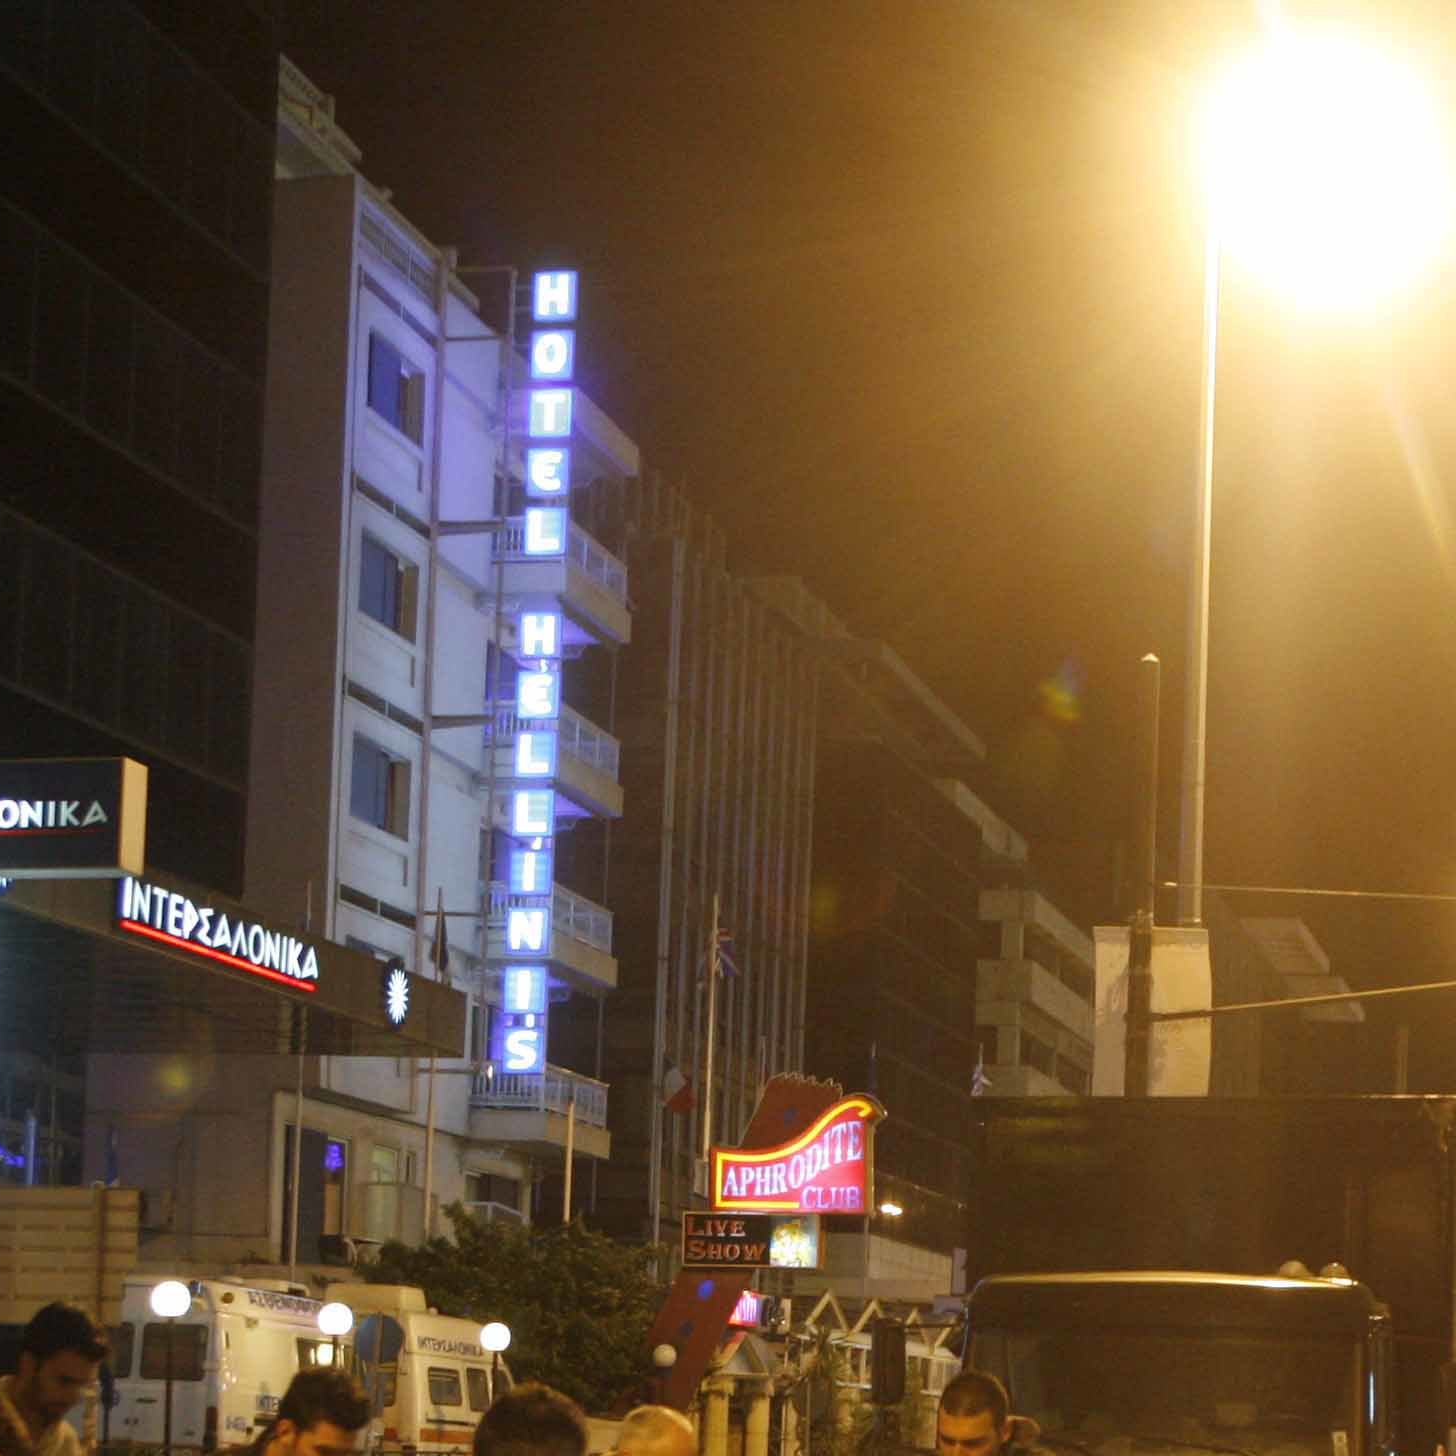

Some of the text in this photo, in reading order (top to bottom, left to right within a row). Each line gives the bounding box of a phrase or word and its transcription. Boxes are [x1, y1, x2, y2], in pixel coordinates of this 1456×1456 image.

[505, 272, 570, 1071] HOTEL HELLINIS
[120, 875, 319, 980] ΙΝΤΕΡΣΑΛΟΝΙΚΑ
[722, 1120, 864, 1197] APHRODITE
[801, 1185, 862, 1210] CLUB
[687, 1216, 748, 1238] LIVE
[688, 1241, 769, 1262] SHOW
